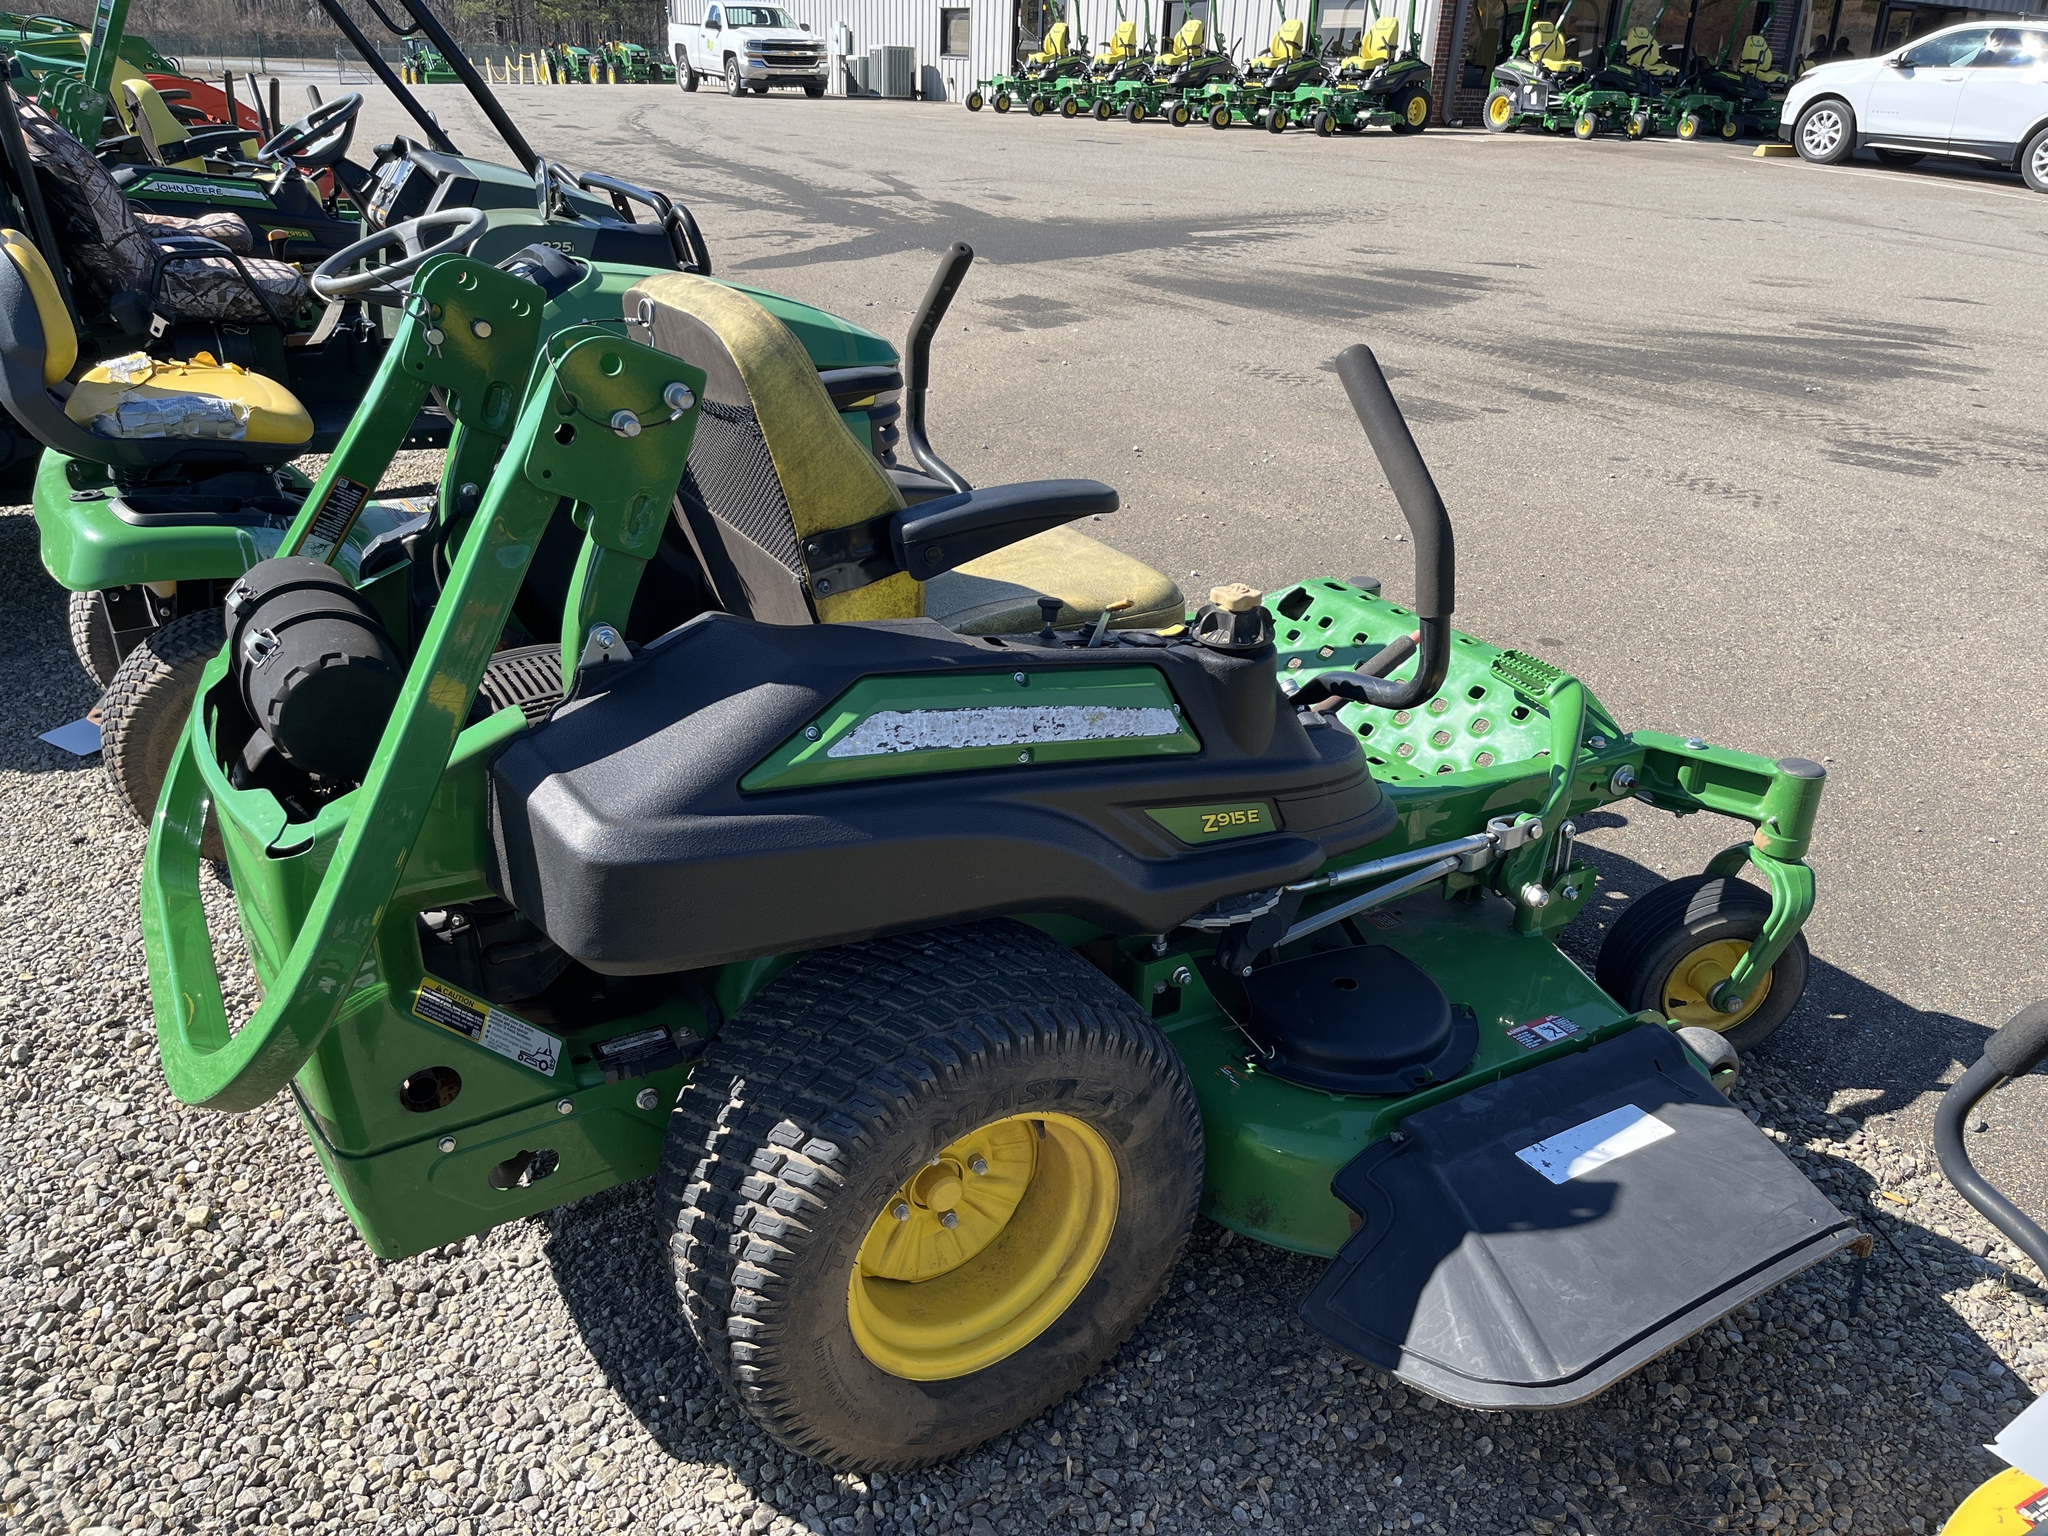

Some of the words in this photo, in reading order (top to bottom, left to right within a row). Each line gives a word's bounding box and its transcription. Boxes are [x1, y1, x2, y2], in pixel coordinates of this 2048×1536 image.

[153, 182, 185, 193] JOHN
[185, 184, 224, 196] DEERE
[442, 986, 475, 1008] CAUTION
